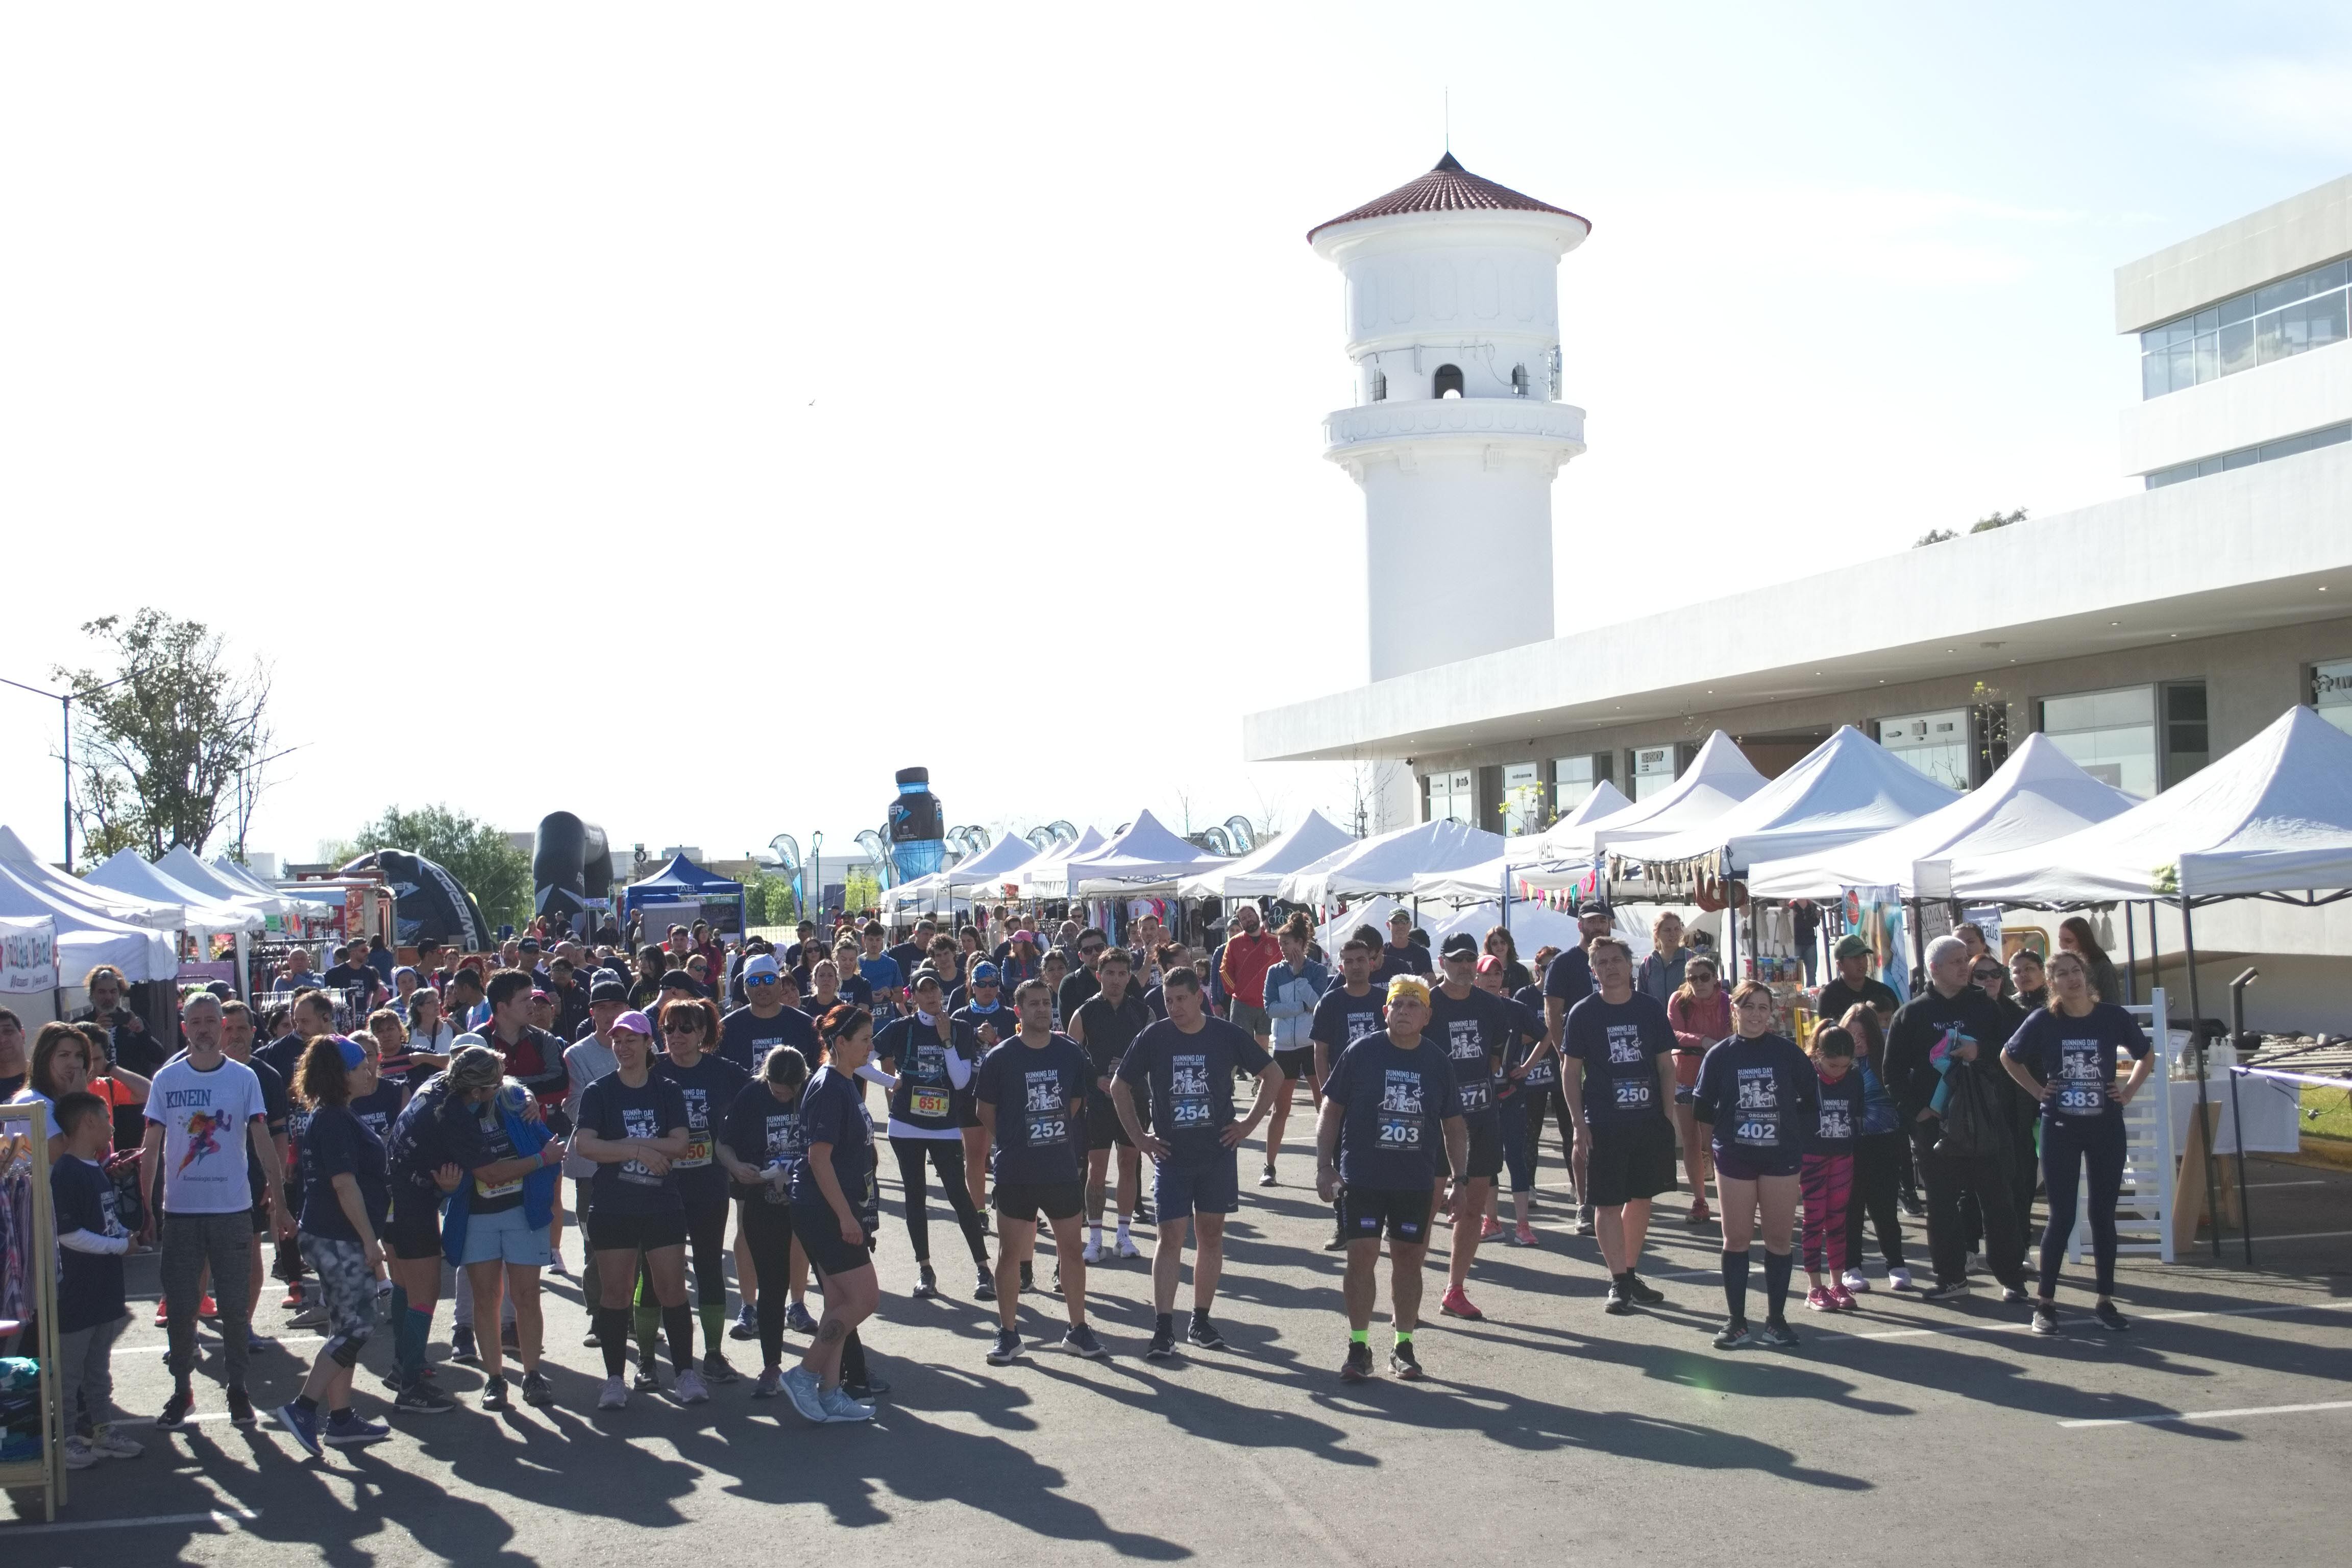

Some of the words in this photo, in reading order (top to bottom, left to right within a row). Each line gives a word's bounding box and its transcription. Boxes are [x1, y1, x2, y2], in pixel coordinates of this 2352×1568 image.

[870, 1007, 888, 1016] 287
[1025, 1070, 1047, 1079] RUNNING
[1386, 1069, 1409, 1078] RUNNING
[166, 1089, 212, 1108] KINEIN
[1460, 1089, 1486, 1106] 271
[1616, 1088, 1649, 1102] 250
[2061, 1091, 2099, 1107] 383
[919, 1096, 941, 1110] 651
[767, 1115, 789, 1123] RUNNING
[1174, 1105, 1210, 1121] 254
[1030, 1121, 1065, 1139] 252
[1380, 1125, 1418, 1142] 203
[1737, 1123, 1775, 1138] 402
